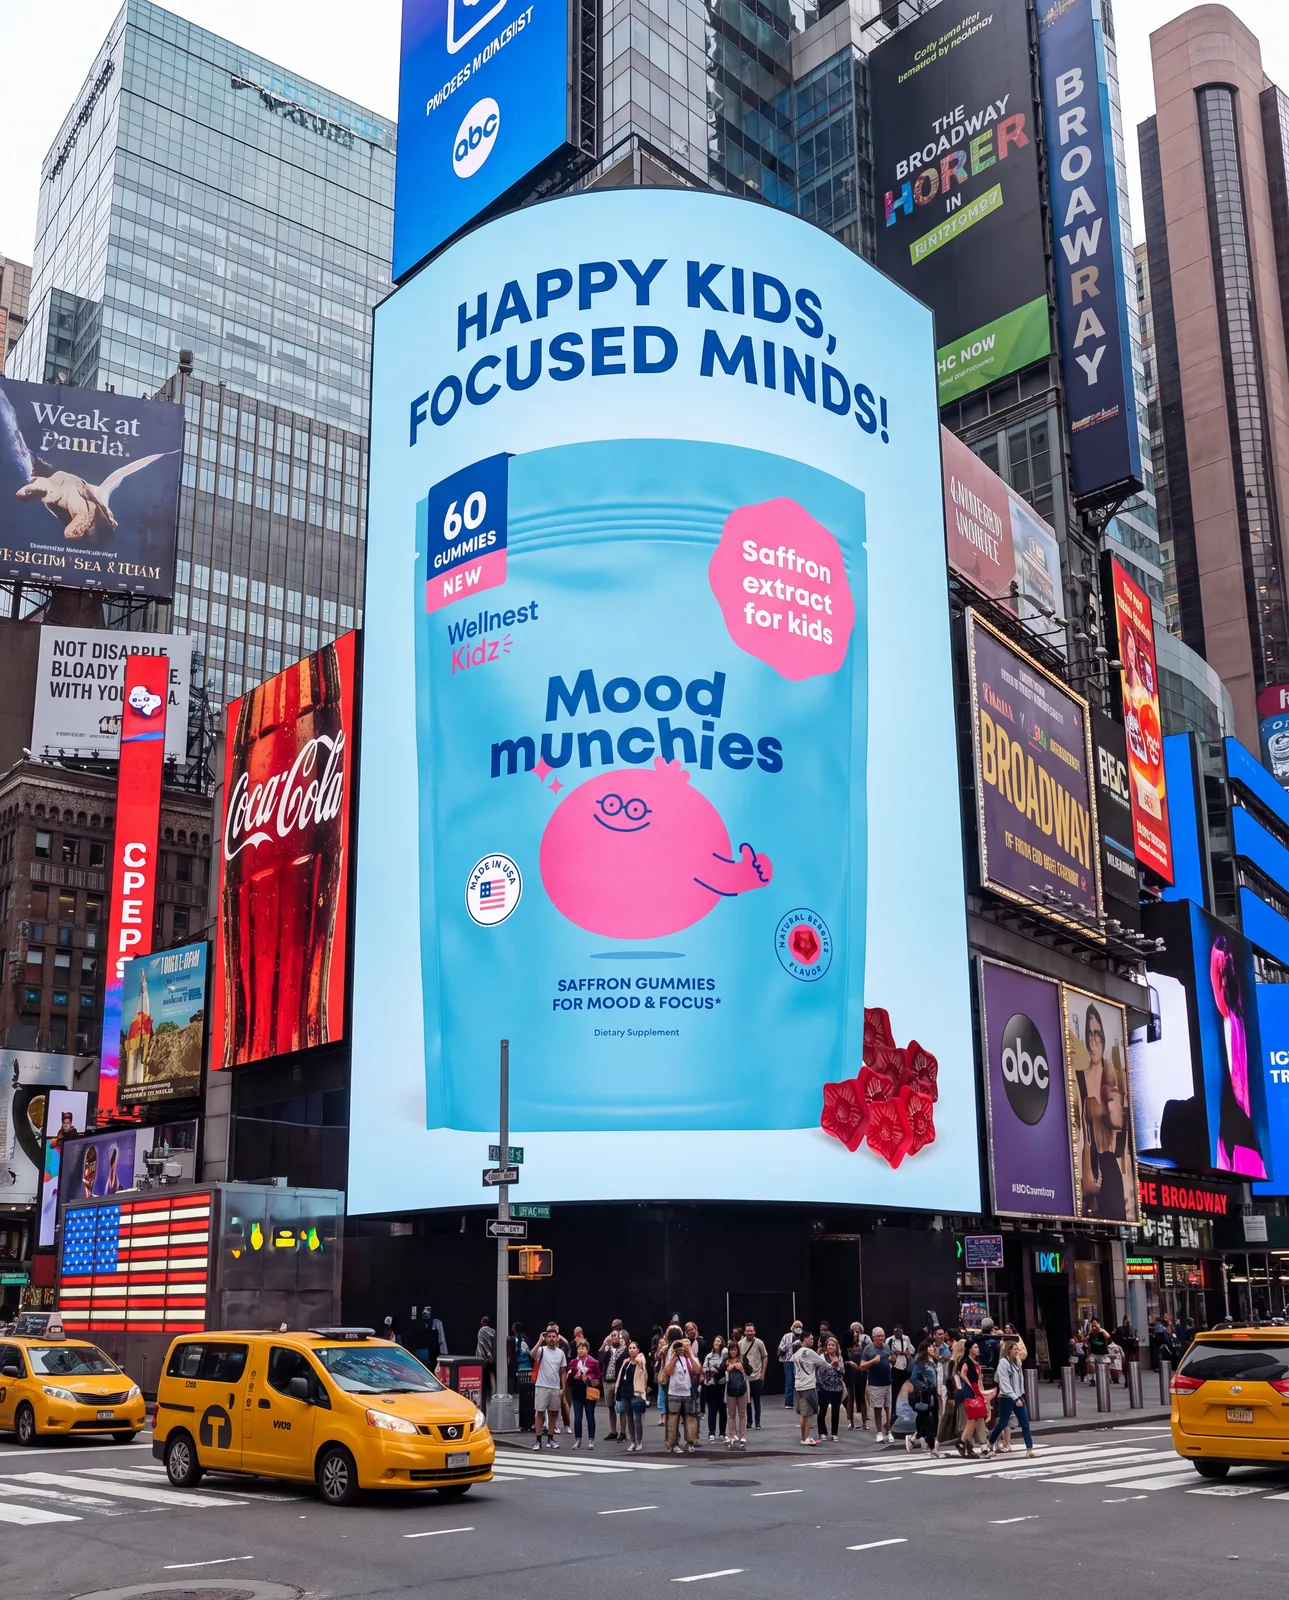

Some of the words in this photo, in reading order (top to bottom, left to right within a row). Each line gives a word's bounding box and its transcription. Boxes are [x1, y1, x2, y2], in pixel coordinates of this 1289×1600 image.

[455, 113, 498, 162] abc
[896, 94, 1010, 180] BROADWAY
[932, 104, 965, 135] THE
[884, 113, 1030, 228] HORER
[946, 192, 962, 213] IN
[457, 258, 669, 353] HAPPY
[686, 260, 837, 356] KIDS,
[960, 333, 996, 363] NOW
[409, 325, 679, 448] FOCUSED
[699, 328, 890, 444] MINDS!
[30, 401, 109, 433] Weak
[114, 417, 141, 437] at
[443, 490, 487, 540] 60
[433, 530, 497, 568] GUMMIES
[742, 539, 831, 585] Saffron
[443, 565, 482, 598] NEW
[742, 576, 833, 616] extract
[447, 600, 539, 646] Wellnest
[743, 602, 783, 630] for
[788, 610, 833, 646] kids
[53, 640, 87, 658] NOT
[451, 637, 500, 675] Kidz
[51, 660, 119, 681] BLOADY
[49, 681, 92, 700] WITH
[545, 668, 727, 722] Mood
[490, 716, 784, 779] munchies
[980, 708, 1090, 871] BROADWAY
[470, 862, 490, 891] MADE
[491, 860, 502, 869] IN
[502, 863, 516, 885] USA
[779, 913, 805, 948] NATURAL
[557, 977, 631, 992] SAFFRON
[635, 977, 716, 991] GUMMIES
[789, 962, 822, 977] FLAVOR
[552, 997, 583, 1011] FOR
[587, 996, 641, 1010] MOOD
[644, 996, 656, 1009] &
[594, 1028, 626, 1038] Dietary
[627, 1028, 680, 1038] Supplement
[1001, 1037, 1049, 1090] abc
[1161, 1184, 1227, 1215] BROADWAY
